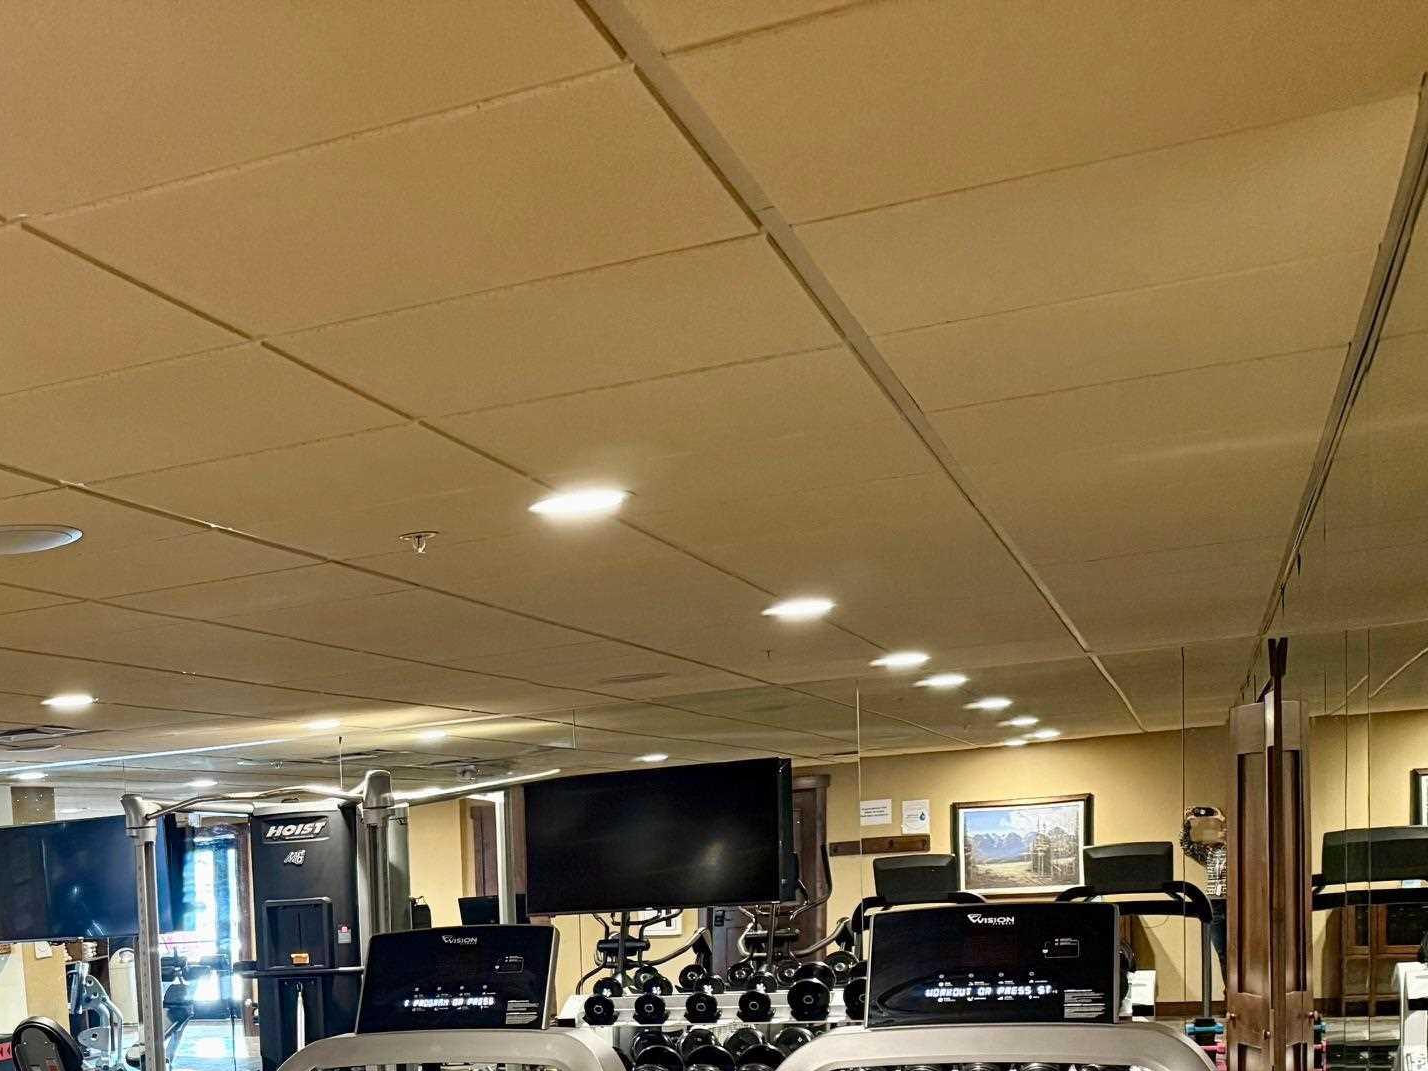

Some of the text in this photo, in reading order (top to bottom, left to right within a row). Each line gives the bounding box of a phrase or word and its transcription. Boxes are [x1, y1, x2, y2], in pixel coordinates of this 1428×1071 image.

[265, 821, 326, 838] HOIST
[925, 988, 972, 998] WORKOUT
[977, 986, 992, 996] OR
[996, 985, 1032, 995] PRESS
